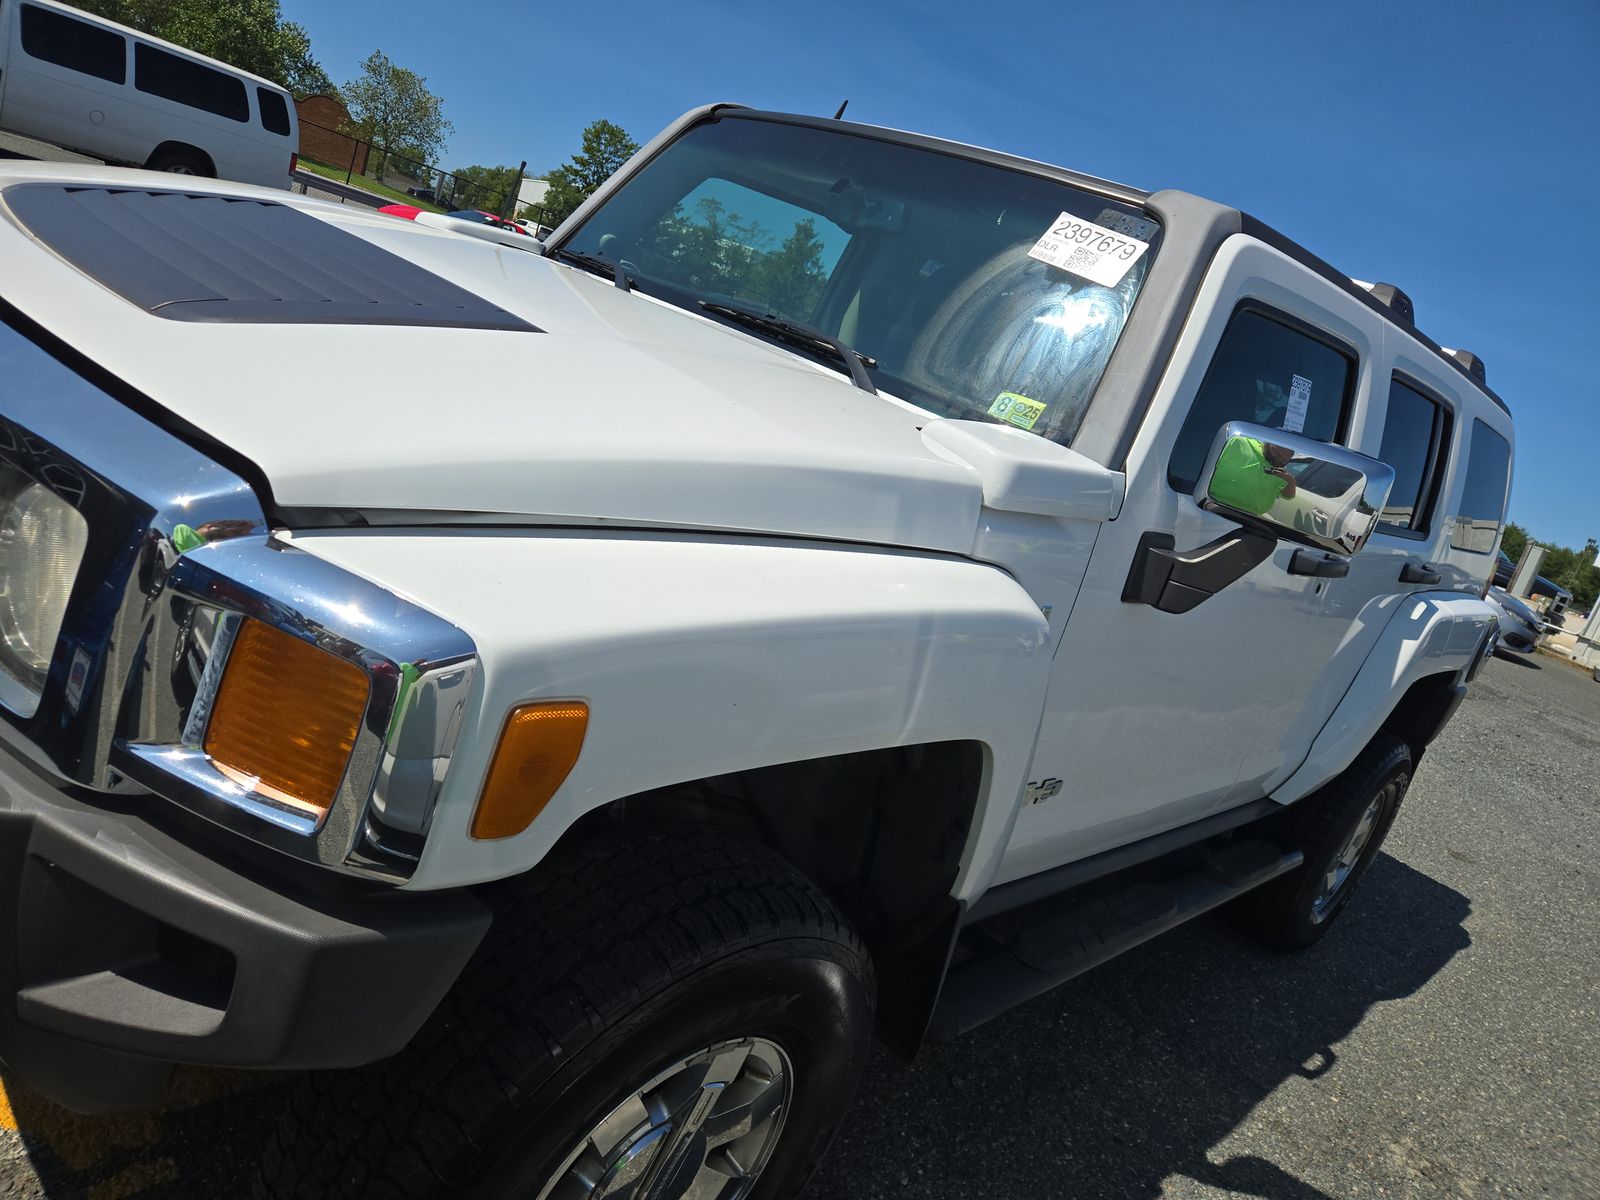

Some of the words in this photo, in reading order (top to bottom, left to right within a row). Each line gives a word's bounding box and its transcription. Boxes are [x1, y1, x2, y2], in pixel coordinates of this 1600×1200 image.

[1037, 240, 1059, 253] DLR
[1052, 221, 1137, 261] 2397679
[996, 396, 1012, 412] 8
[1022, 405, 1041, 420] 25
